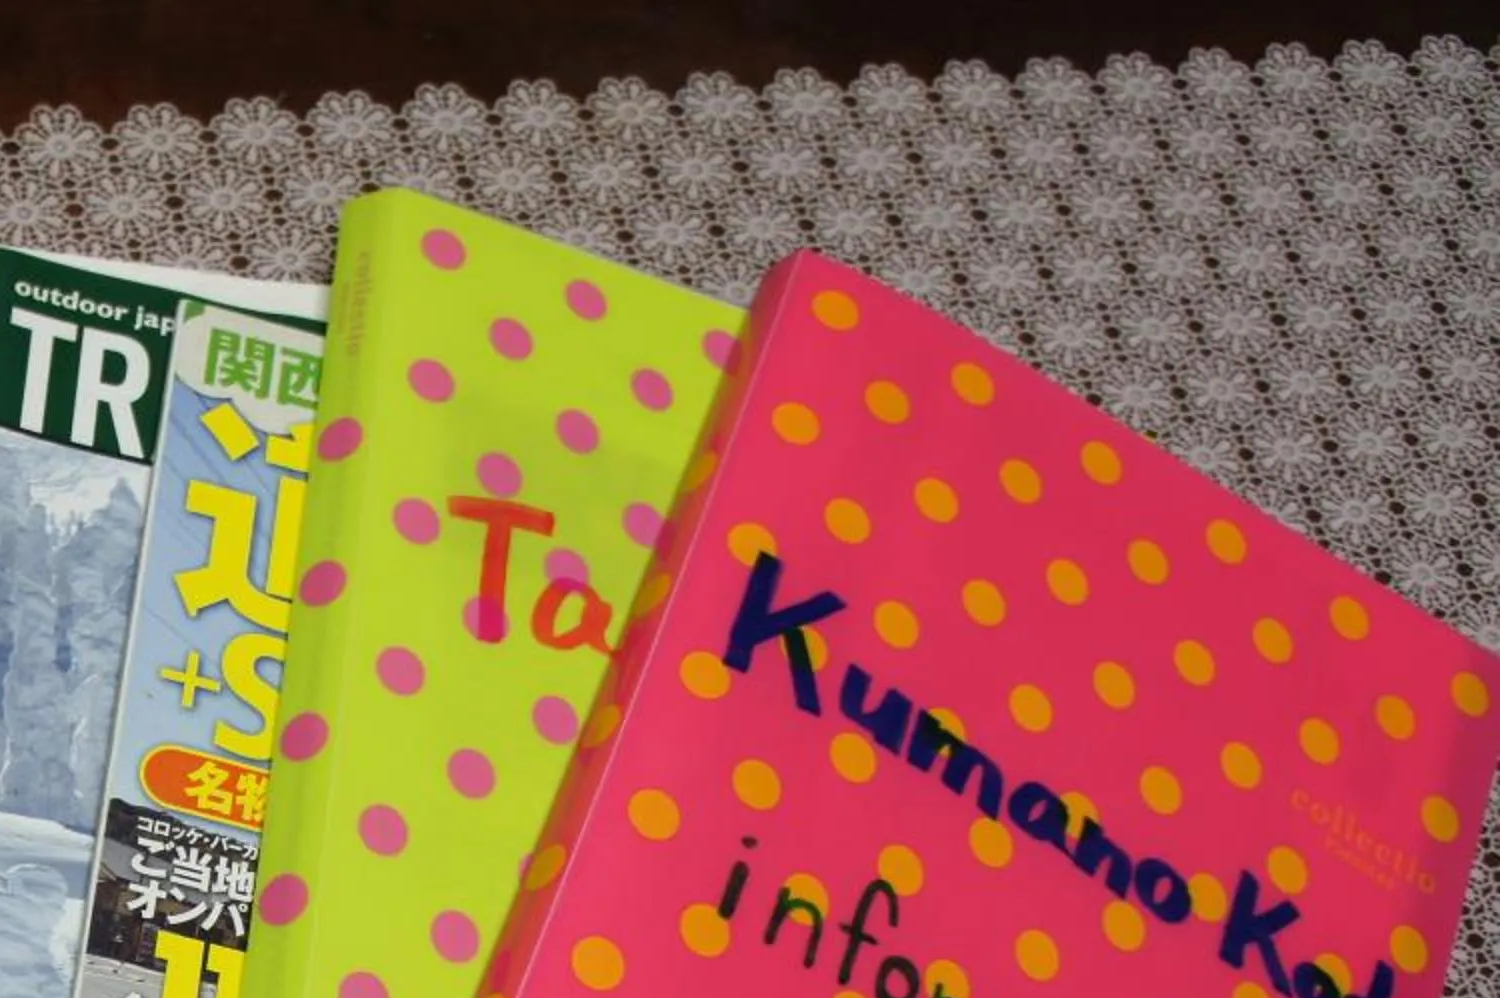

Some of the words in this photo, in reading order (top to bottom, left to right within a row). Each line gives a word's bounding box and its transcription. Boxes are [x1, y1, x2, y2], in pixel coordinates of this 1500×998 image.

[13, 278, 128, 323] outdoor
[9, 307, 151, 459] TR
[204, 327, 325, 411] 関西
[721, 549, 1197, 926] Kumano
[185, 761, 269, 831] 名物
[132, 838, 256, 904] ご当地
